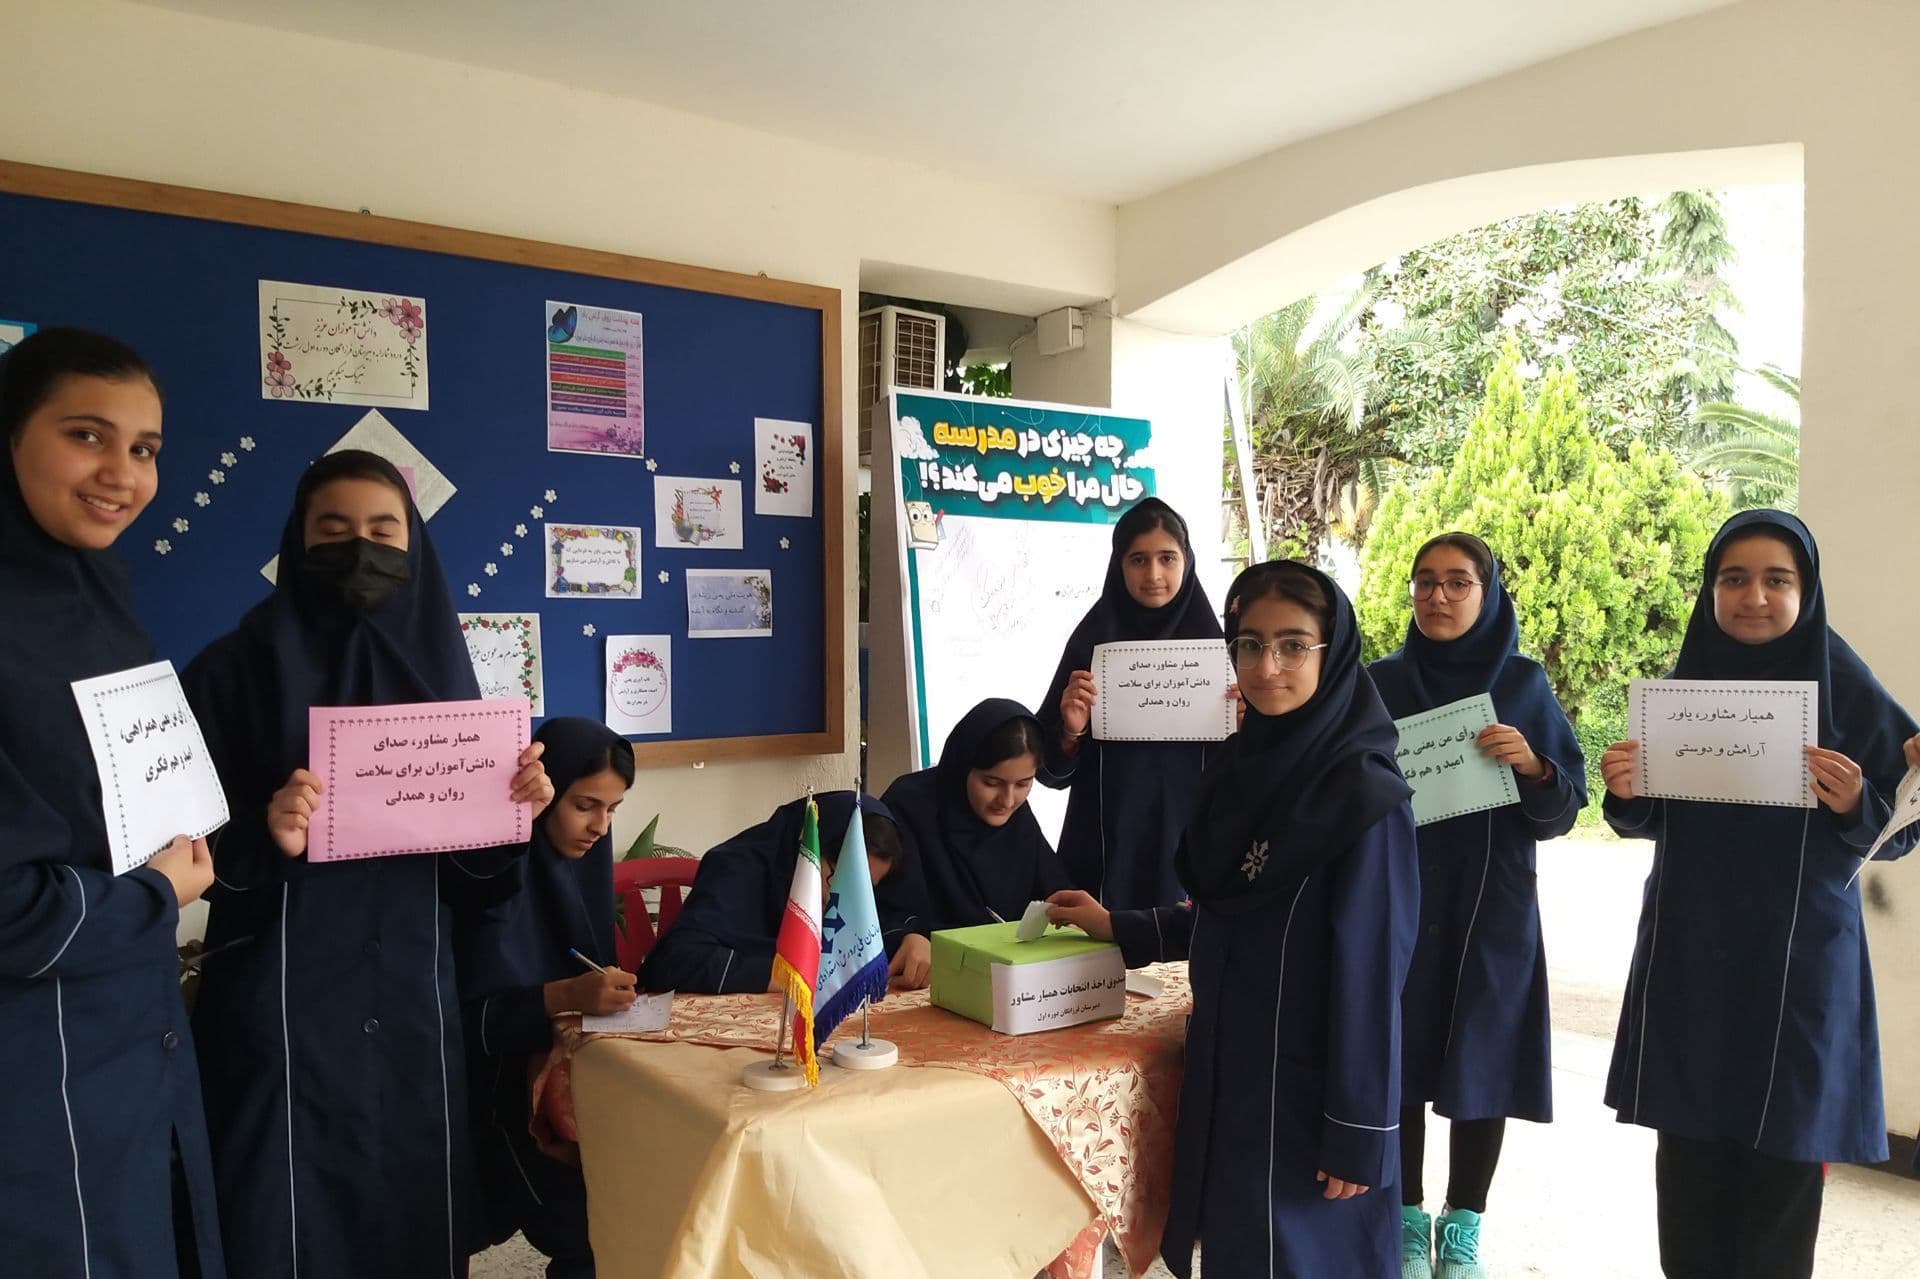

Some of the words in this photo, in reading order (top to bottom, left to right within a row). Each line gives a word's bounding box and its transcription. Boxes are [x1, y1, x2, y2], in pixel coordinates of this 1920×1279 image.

[933, 421, 1017, 455] مدرسه
[1018, 428, 1042, 458] در
[1042, 429, 1094, 466] چیزی
[1094, 435, 1124, 468] چه
[1014, 468, 1066, 504] خوب
[1067, 471, 1101, 506] مرا
[1101, 474, 1144, 507] حال
[1128, 660, 1151, 672] صدای
[1180, 660, 1199, 671] همیار
[1118, 680, 1142, 688] سلامت
[1143, 679, 1161, 690] برای
[1138, 697, 1164, 708] همدلی
[1171, 697, 1191, 708] روان
[1667, 707, 1693, 721] یاور
[1695, 707, 1736, 722] مشاور،
[1740, 708, 1775, 724] همیار
[373, 734, 408, 752] صدای
[450, 731, 481, 748] همیار
[1438, 735, 1452, 748] من
[1413, 740, 1436, 756] یعنی
[1675, 744, 1713, 758] دوستی
[1715, 748, 1724, 757] و
[1726, 742, 1767, 757] آرامش
[145, 753, 168, 783] فکری
[1443, 754, 1464, 770] امید
[355, 763, 393, 778] سلامت
[396, 762, 422, 778] برای
[1419, 766, 1432, 779] هم
[1436, 765, 1441, 775] و
[385, 789, 425, 806] همدلی
[429, 792, 435, 804] و
[437, 787, 465, 802] روان
[1091, 979, 1106, 989] اخذ
[1010, 992, 1037, 1007] مشاور
[1038, 989, 1058, 1004] همیار
